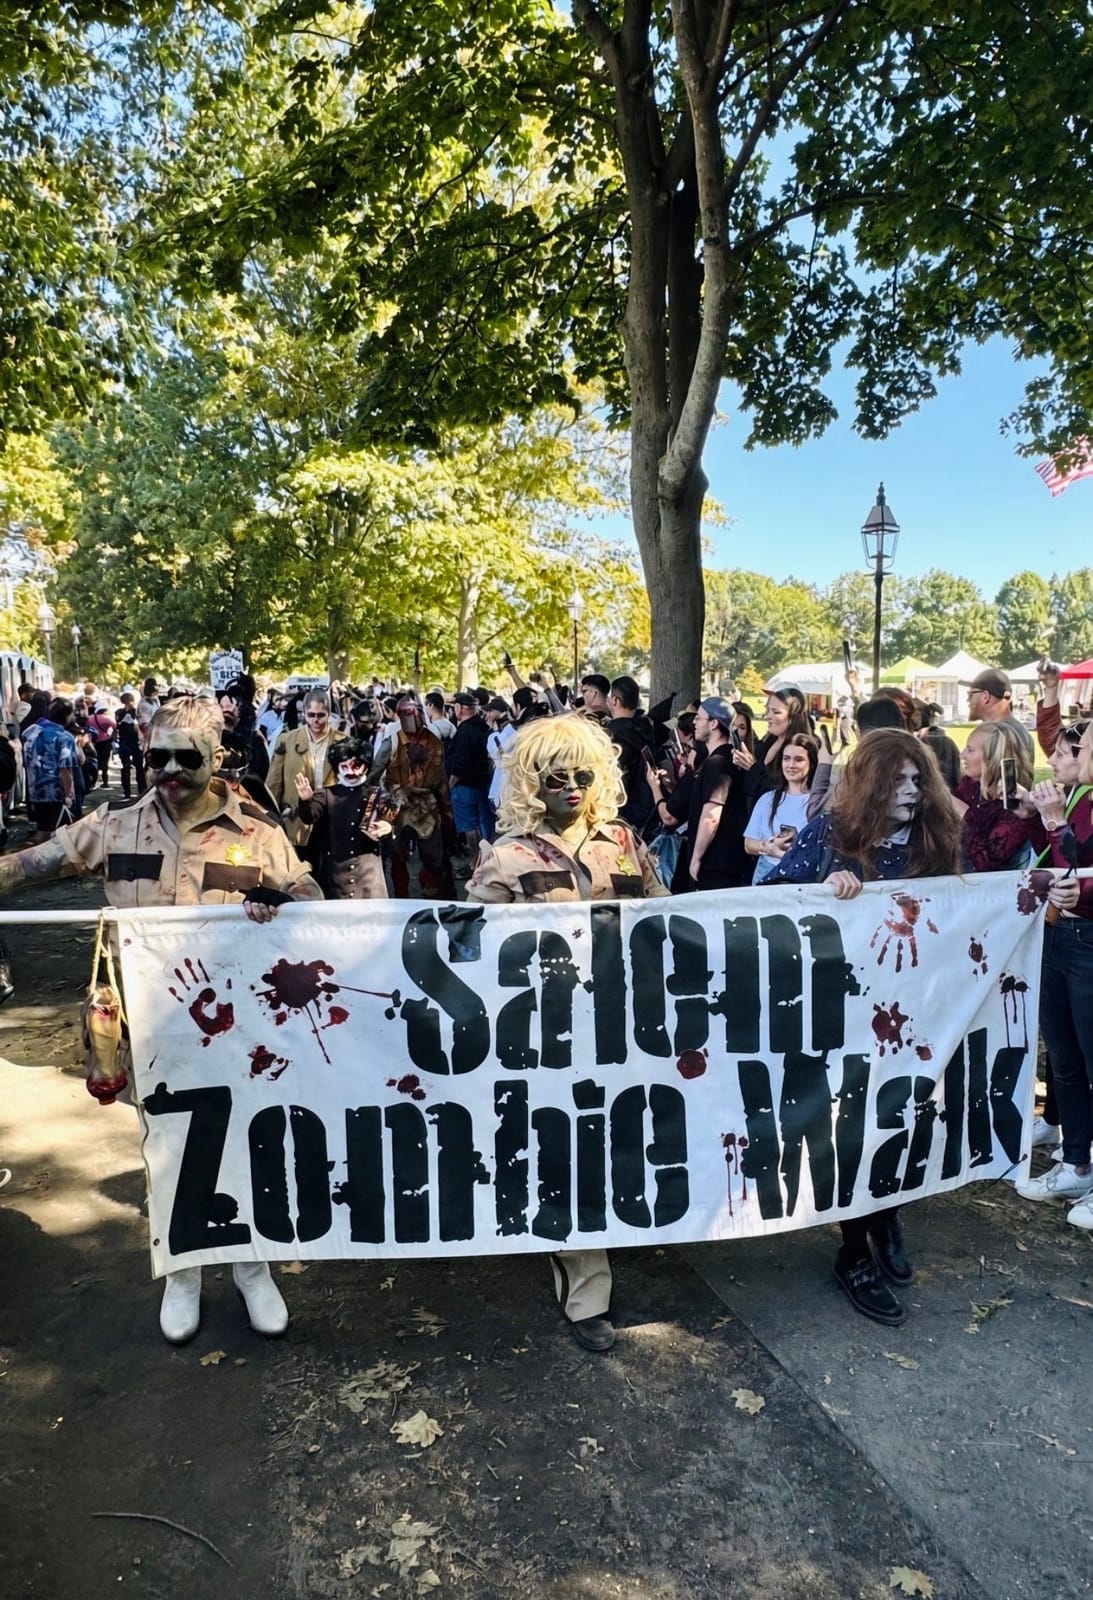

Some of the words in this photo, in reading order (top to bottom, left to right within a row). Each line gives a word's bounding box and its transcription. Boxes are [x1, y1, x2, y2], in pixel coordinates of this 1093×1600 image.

[400, 903, 860, 1076] Salem
[143, 1079, 689, 1255] Zombie
[738, 1027, 1026, 1220] Walk
